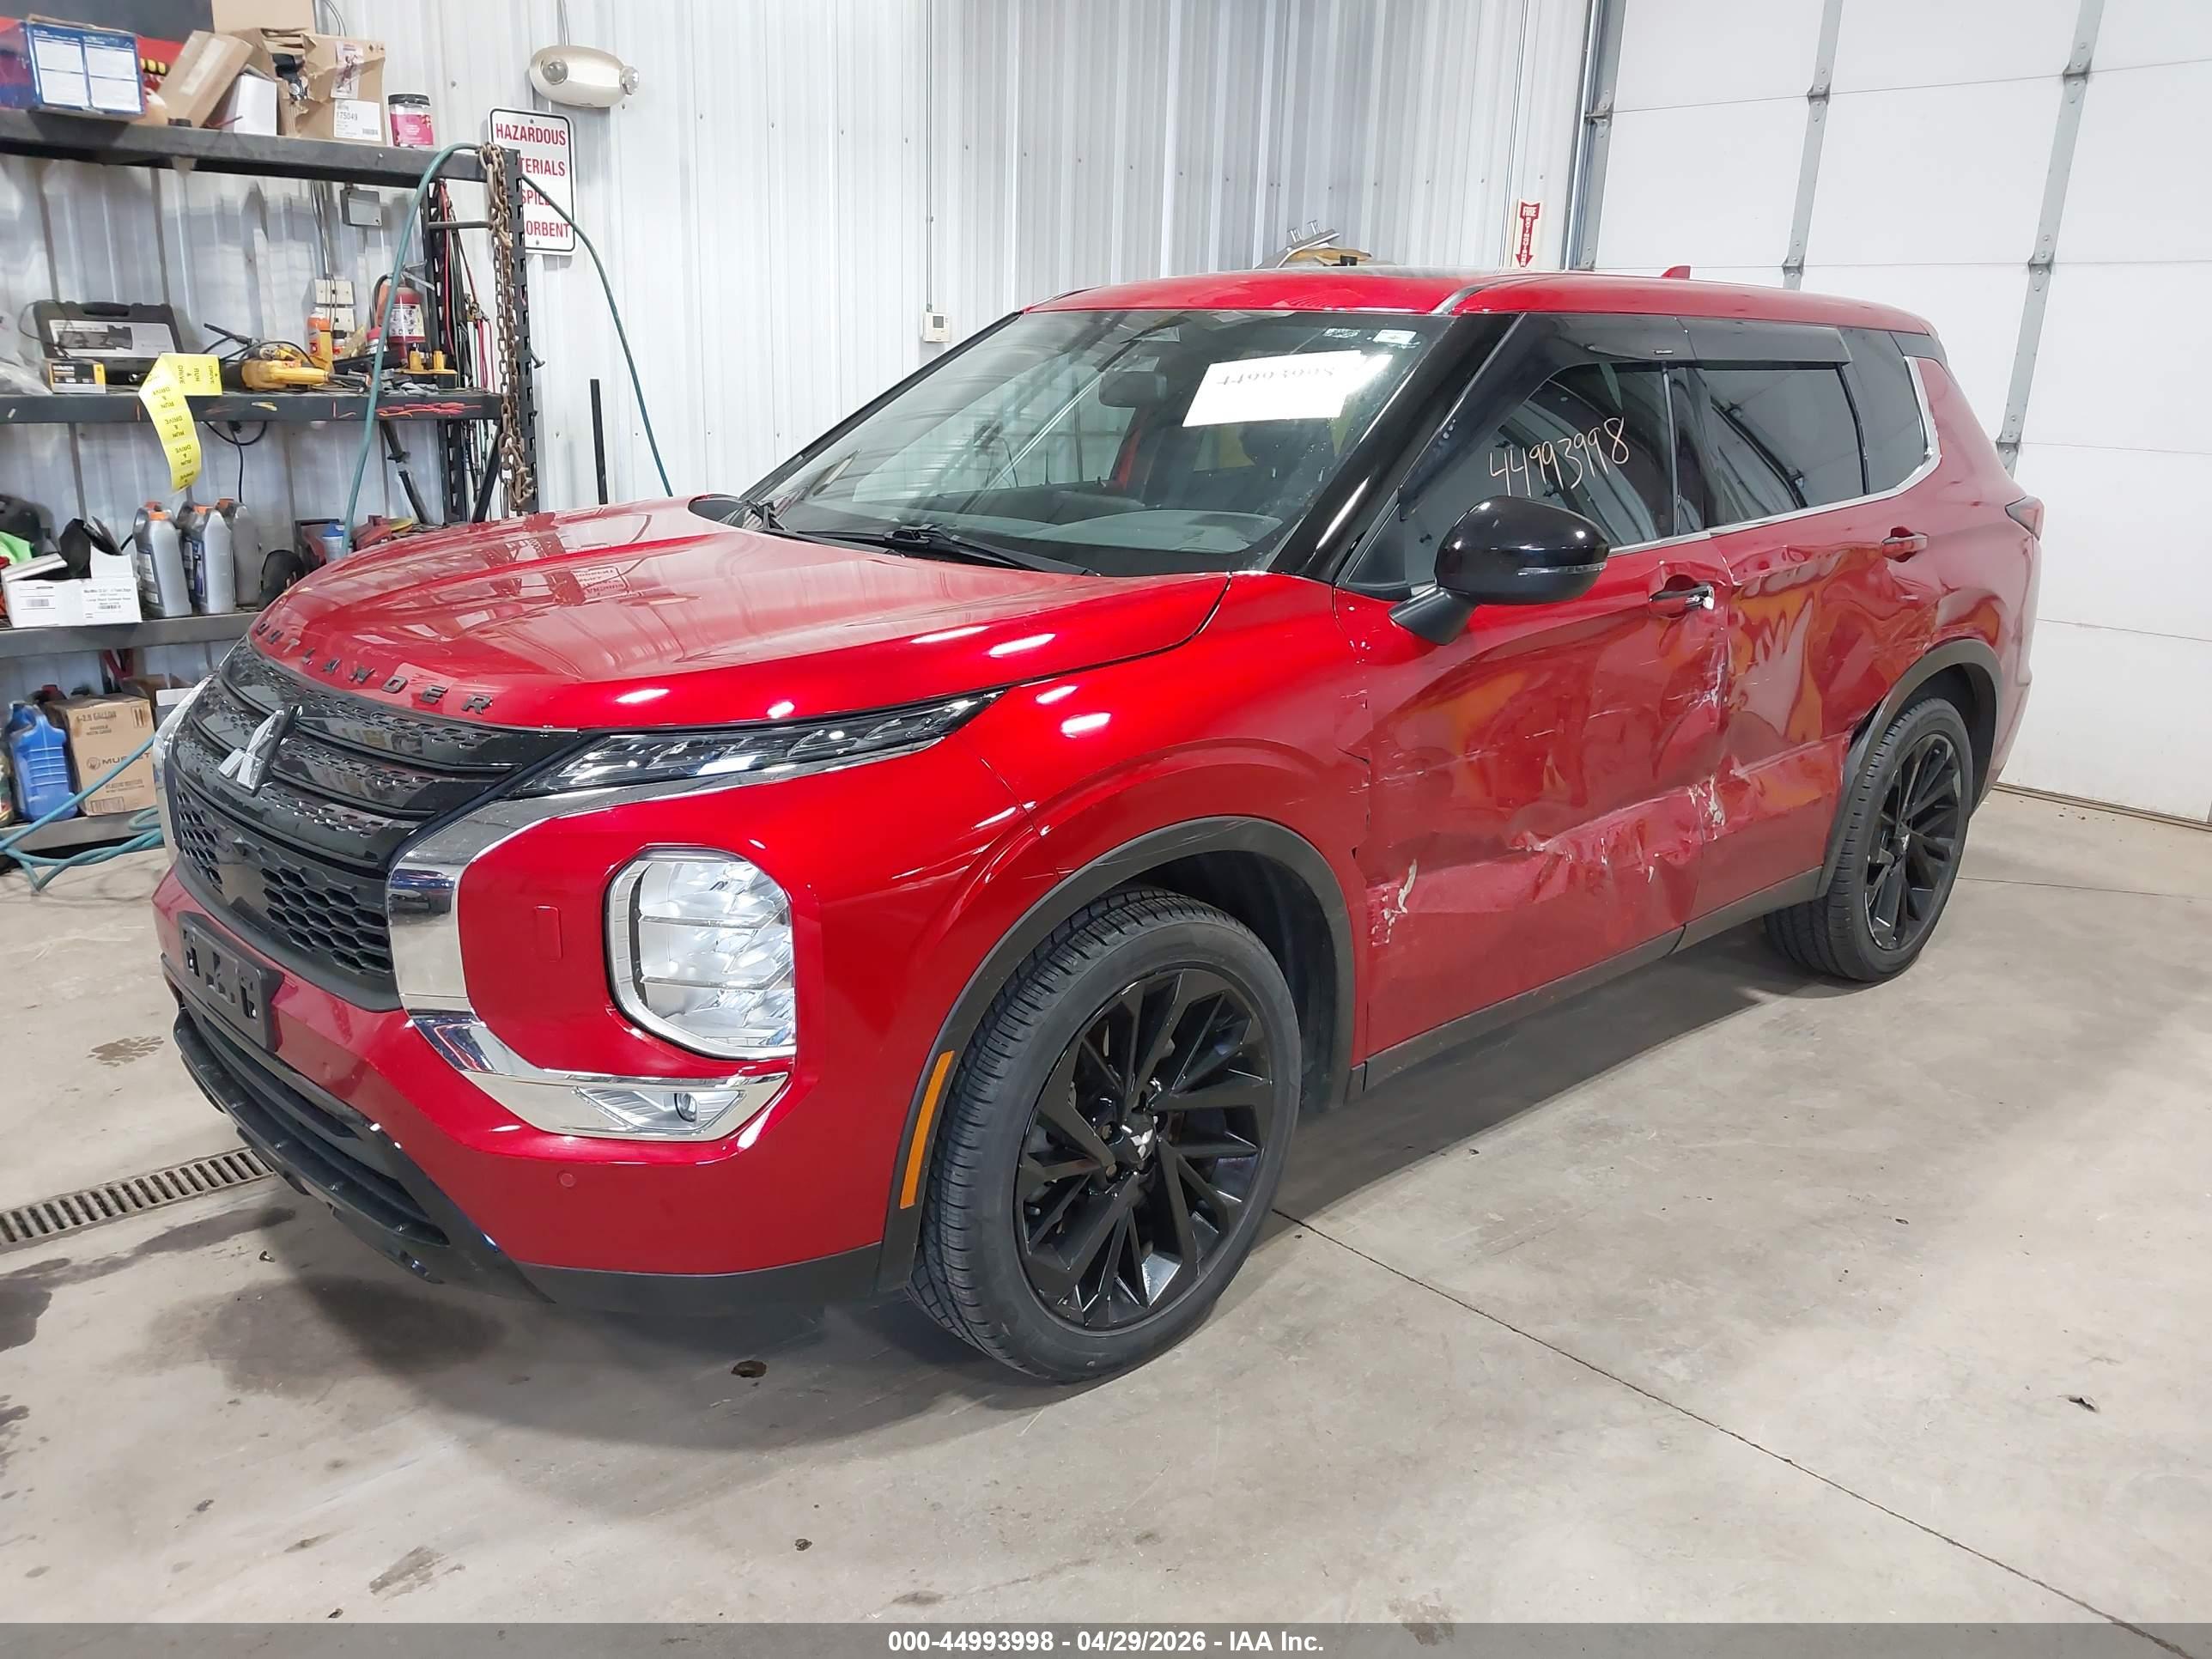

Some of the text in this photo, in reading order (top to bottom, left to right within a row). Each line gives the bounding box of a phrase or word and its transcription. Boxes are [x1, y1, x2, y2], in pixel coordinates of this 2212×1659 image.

[495, 123, 567, 146] HAZARDOUS
[520, 157, 566, 177] TERIALS
[526, 220, 570, 239] ORBENT
[164, 416, 183, 425] DRIVE
[175, 444, 192, 453] DRIVE
[1490, 416, 1630, 498] 44993998
[258, 621, 492, 715] OUTLANDER
[102, 752, 150, 765] MUT
